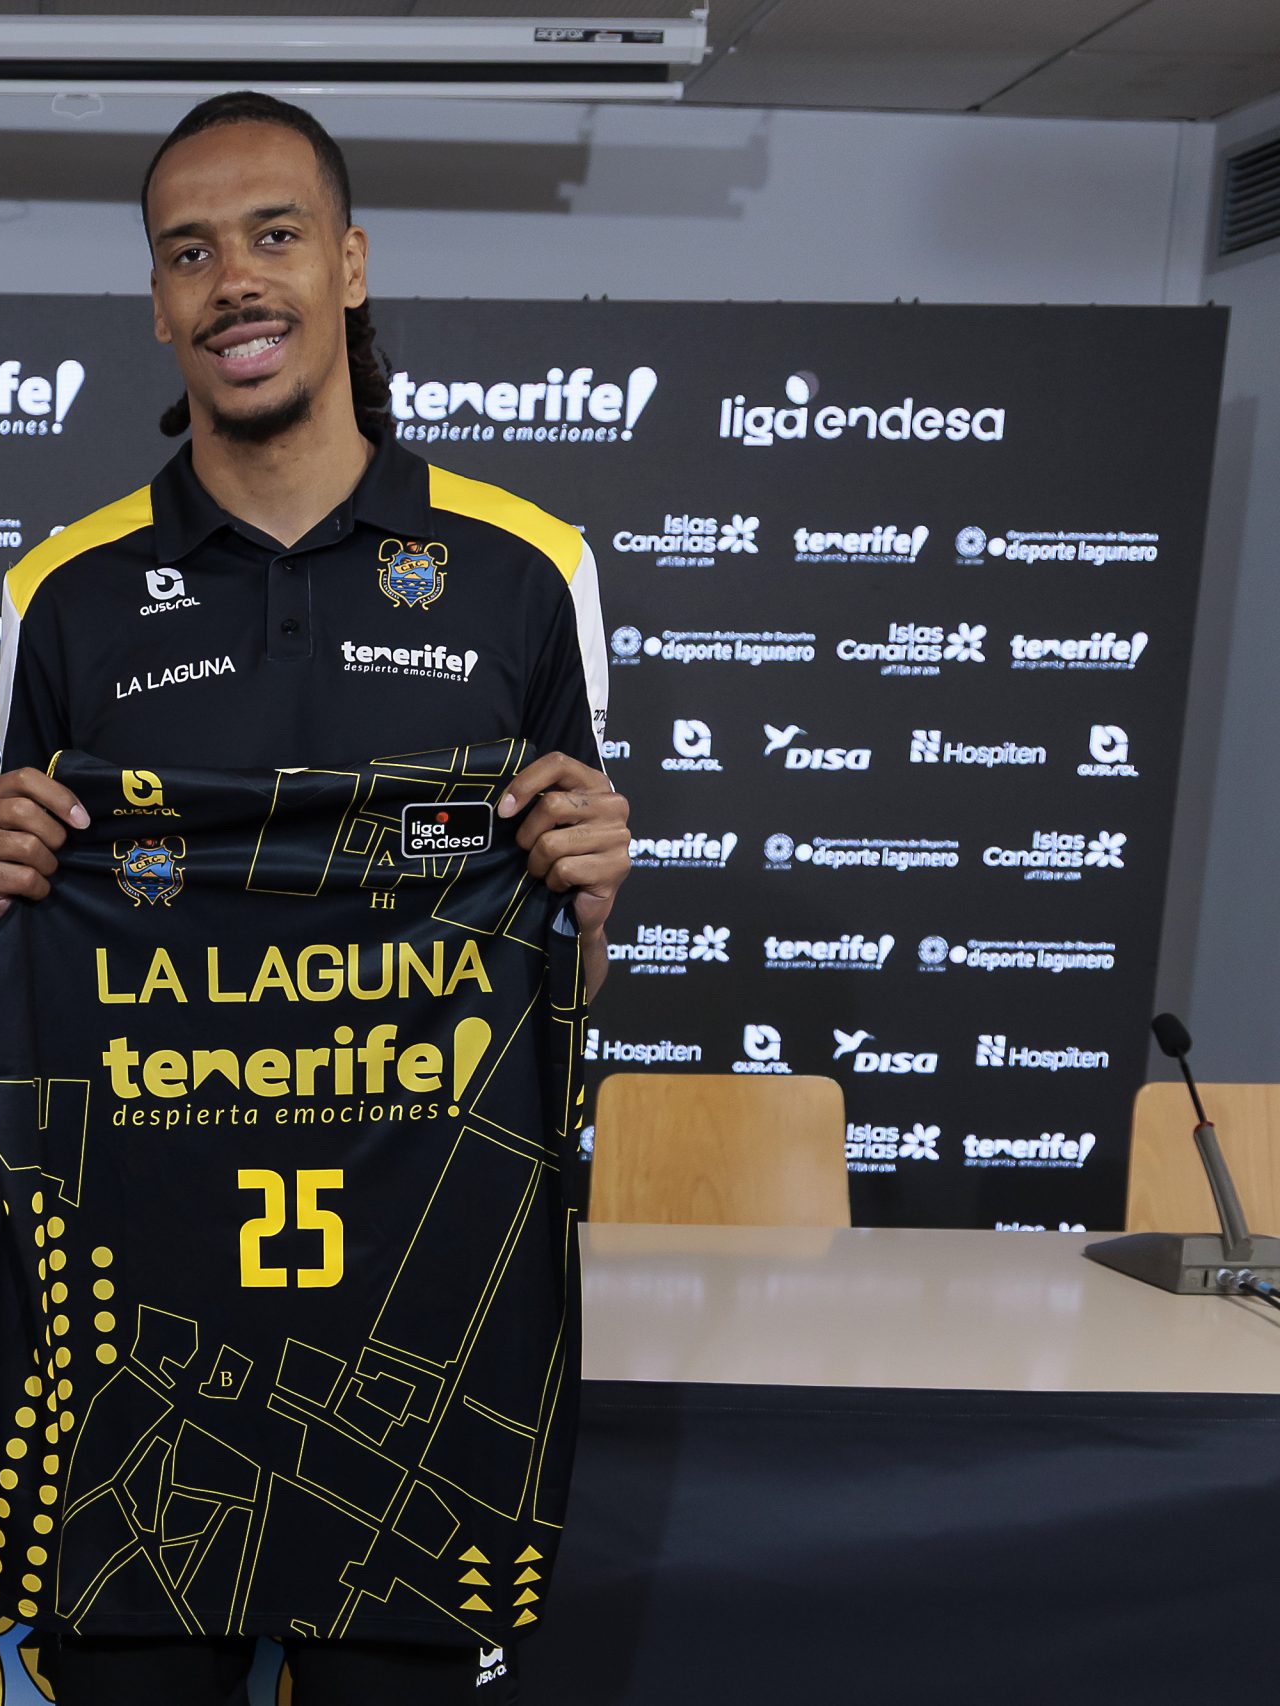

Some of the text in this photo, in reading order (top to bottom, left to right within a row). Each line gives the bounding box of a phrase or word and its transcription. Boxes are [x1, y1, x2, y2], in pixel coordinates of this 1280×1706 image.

[389, 367, 657, 443] tenerife!
[720, 395, 1005, 447] liga endesa
[503, 424, 617, 442] emociones
[663, 513, 718, 535] Islas
[612, 531, 717, 553] Canarias
[794, 526, 929, 563] tenerife!
[1004, 541, 1157, 565] deporte lagunero
[140, 594, 200, 615] austral
[888, 623, 944, 645] Islas
[339, 638, 480, 684] tenerife!
[660, 639, 815, 665] deporte lagunero
[836, 639, 942, 662] Canarias
[1010, 632, 1148, 669] tenerife!
[117, 656, 235, 698] LA LAGUNA
[342, 660, 462, 683] despierta emociones
[785, 748, 871, 770] DISA
[943, 742, 1046, 767] Hospiten
[111, 808, 182, 818] austral
[410, 819, 446, 838] liga
[410, 834, 485, 850] endesa
[627, 831, 738, 868] enerife!
[1032, 830, 1086, 851] Islas
[377, 850, 396, 868] A
[810, 845, 959, 871] deporte lagunero
[982, 846, 1084, 868] Canarias
[370, 892, 397, 911] Hi
[637, 925, 689, 945] Islas
[608, 943, 689, 962] anarias
[764, 935, 894, 969] tenerife!
[965, 948, 1115, 972] deporte lagunero
[96, 939, 493, 1004] LA LAGUNA
[603, 1041, 701, 1064] Hospiten
[851, 1050, 938, 1073] DISA
[1009, 1047, 1109, 1071] Hospiten
[102, 1017, 492, 1118] tenerife!
[112, 1102, 440, 1130] despierta emociones
[845, 1123, 900, 1143] Islas
[844, 1141, 898, 1160] arias
[963, 1133, 1095, 1168] tenerife!
[237, 1169, 344, 1289] 25
[220, 1371, 233, 1388] B
